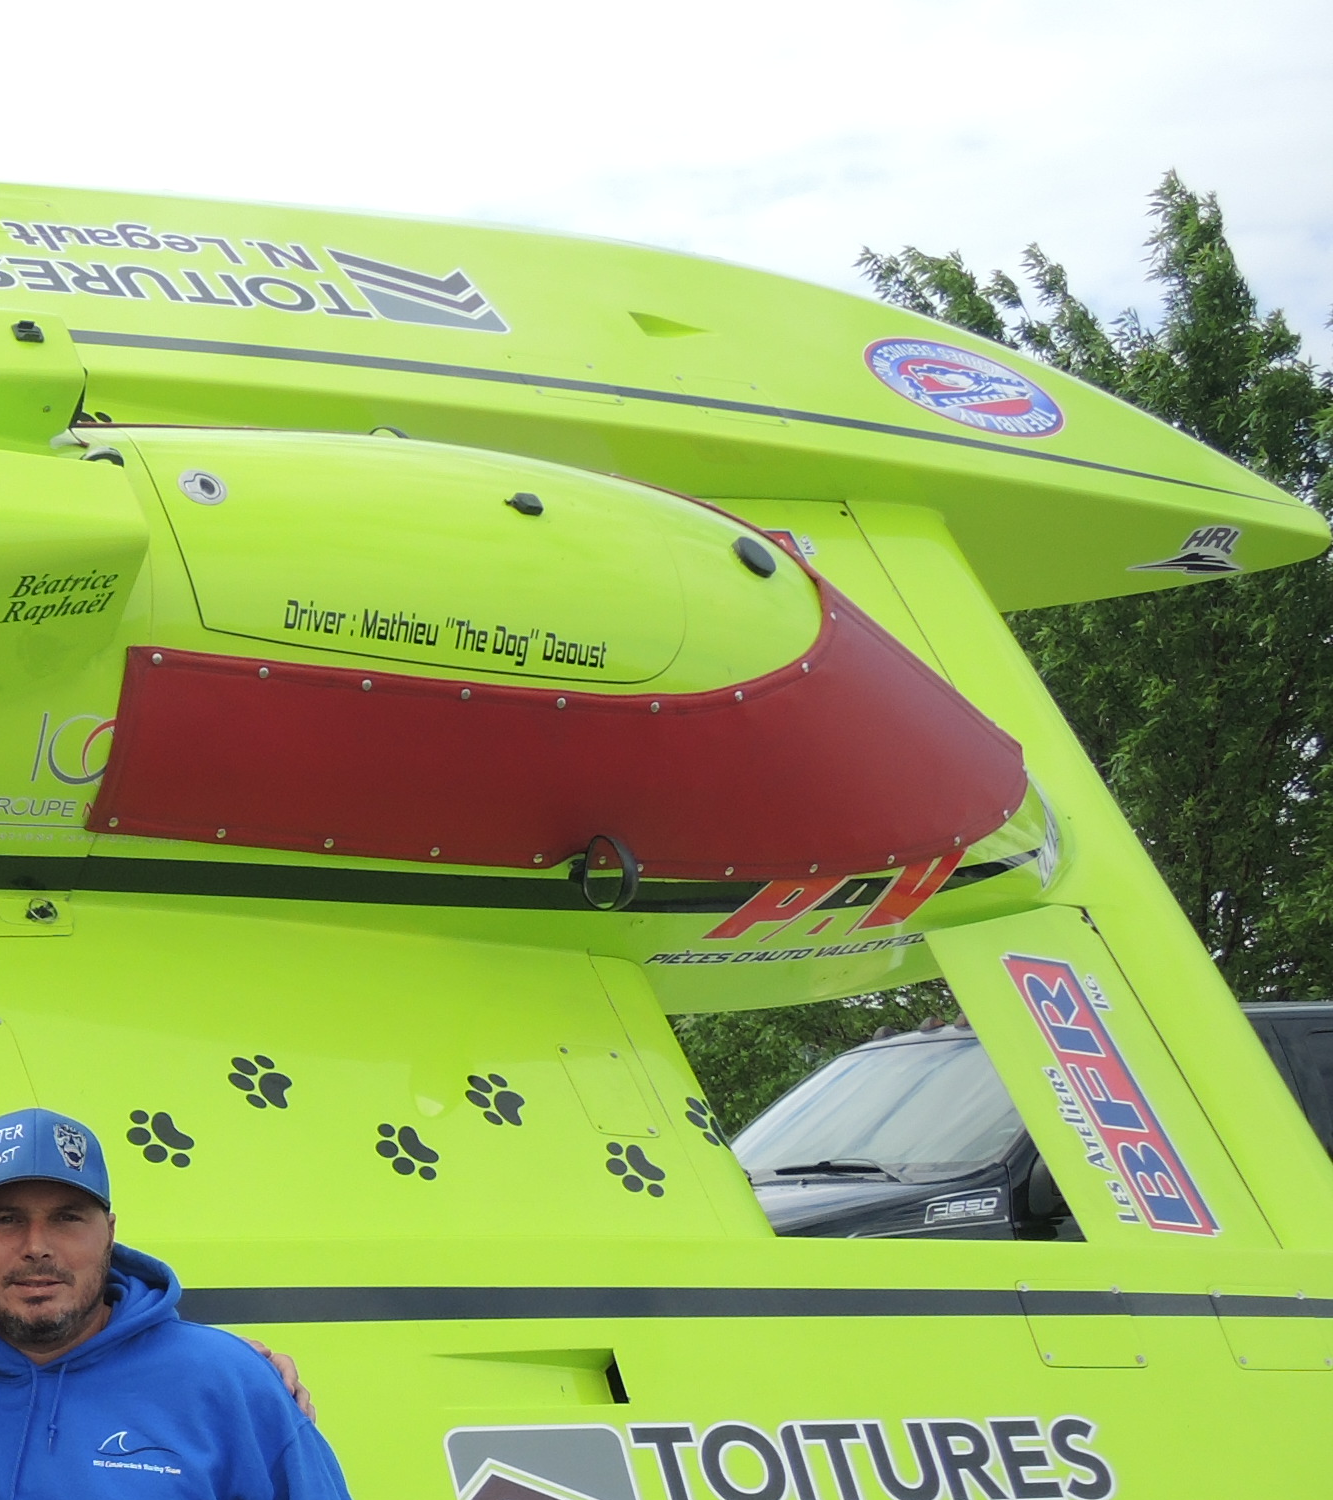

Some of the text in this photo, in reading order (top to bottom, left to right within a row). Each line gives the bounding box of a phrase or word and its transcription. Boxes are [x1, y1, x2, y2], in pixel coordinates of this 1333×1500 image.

[1, 221, 242, 266] Legault
[959, 406, 1057, 433] TREMBLAY
[1181, 526, 1243, 555] HRL
[8, 569, 119, 598] Béatrice
[283, 599, 346, 635] Driver
[360, 609, 439, 647] Mathieu
[542, 632, 608, 669] Daoust
[644, 931, 926, 965] PIÈCES D'AUTO VALLEYFIEL
[1023, 972, 1205, 1229] BFR
[1116, 1180, 1142, 1225] LES
